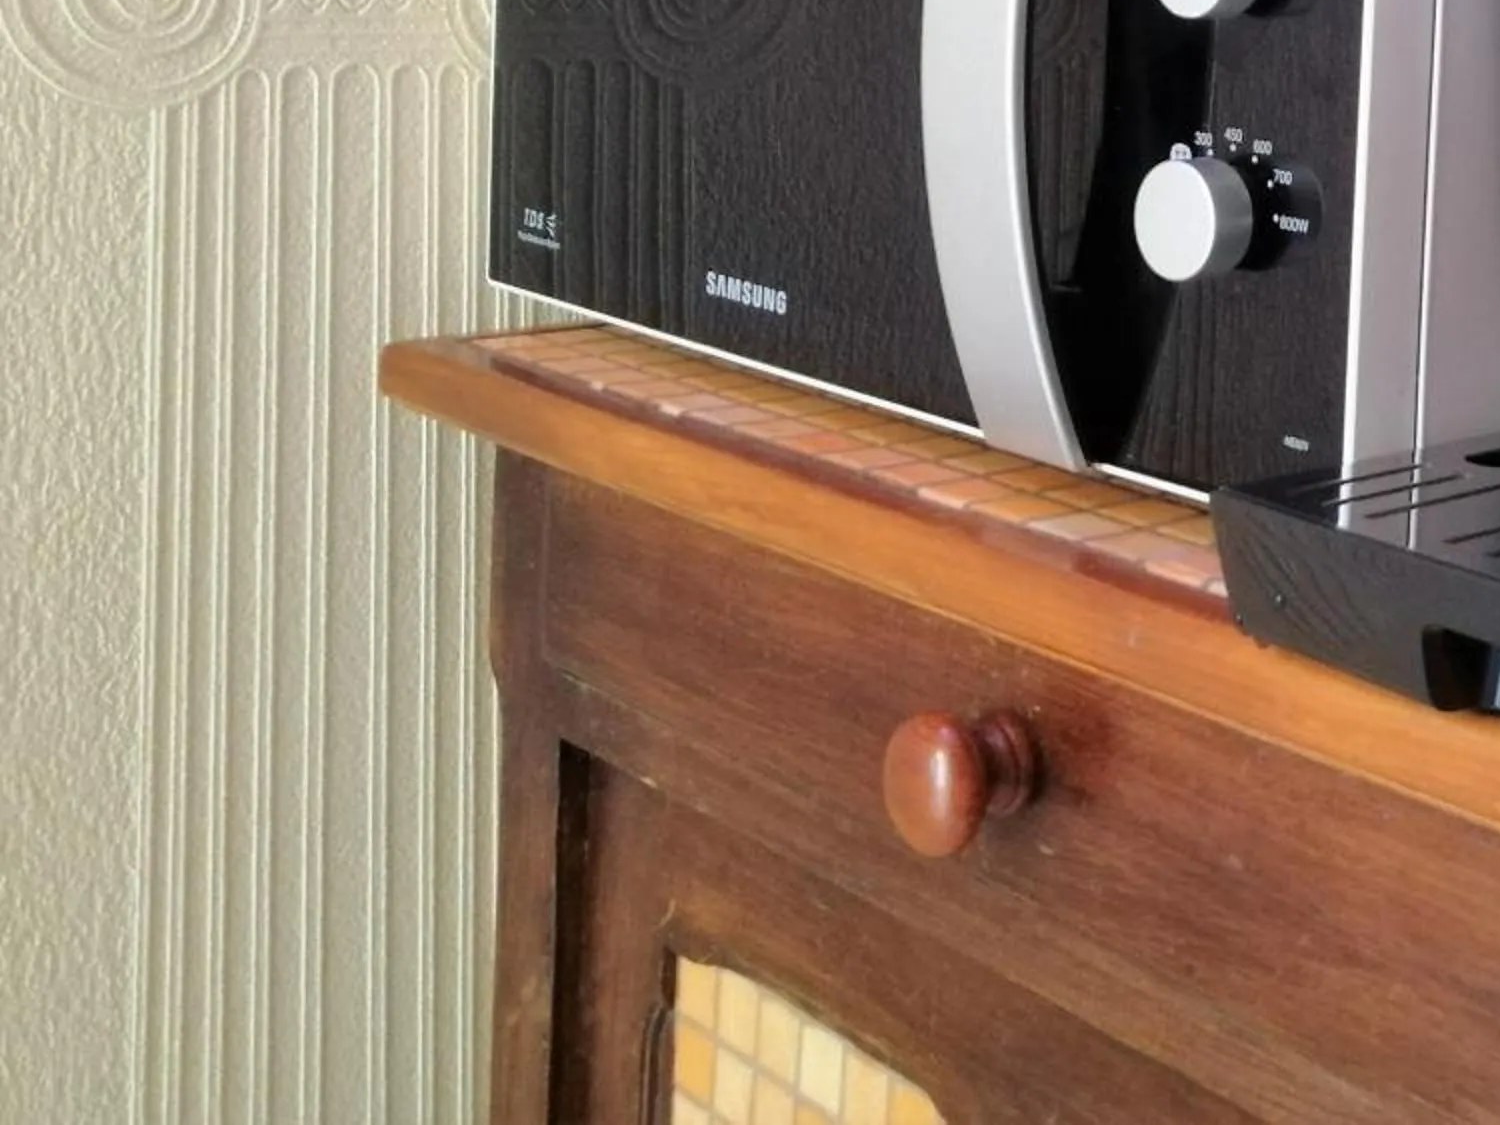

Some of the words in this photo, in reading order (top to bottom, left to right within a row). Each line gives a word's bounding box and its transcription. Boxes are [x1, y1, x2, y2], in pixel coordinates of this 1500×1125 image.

[1224, 127, 1243, 144] 450
[1273, 169, 1293, 186] 700
[705, 270, 788, 315] SAMSUNG
